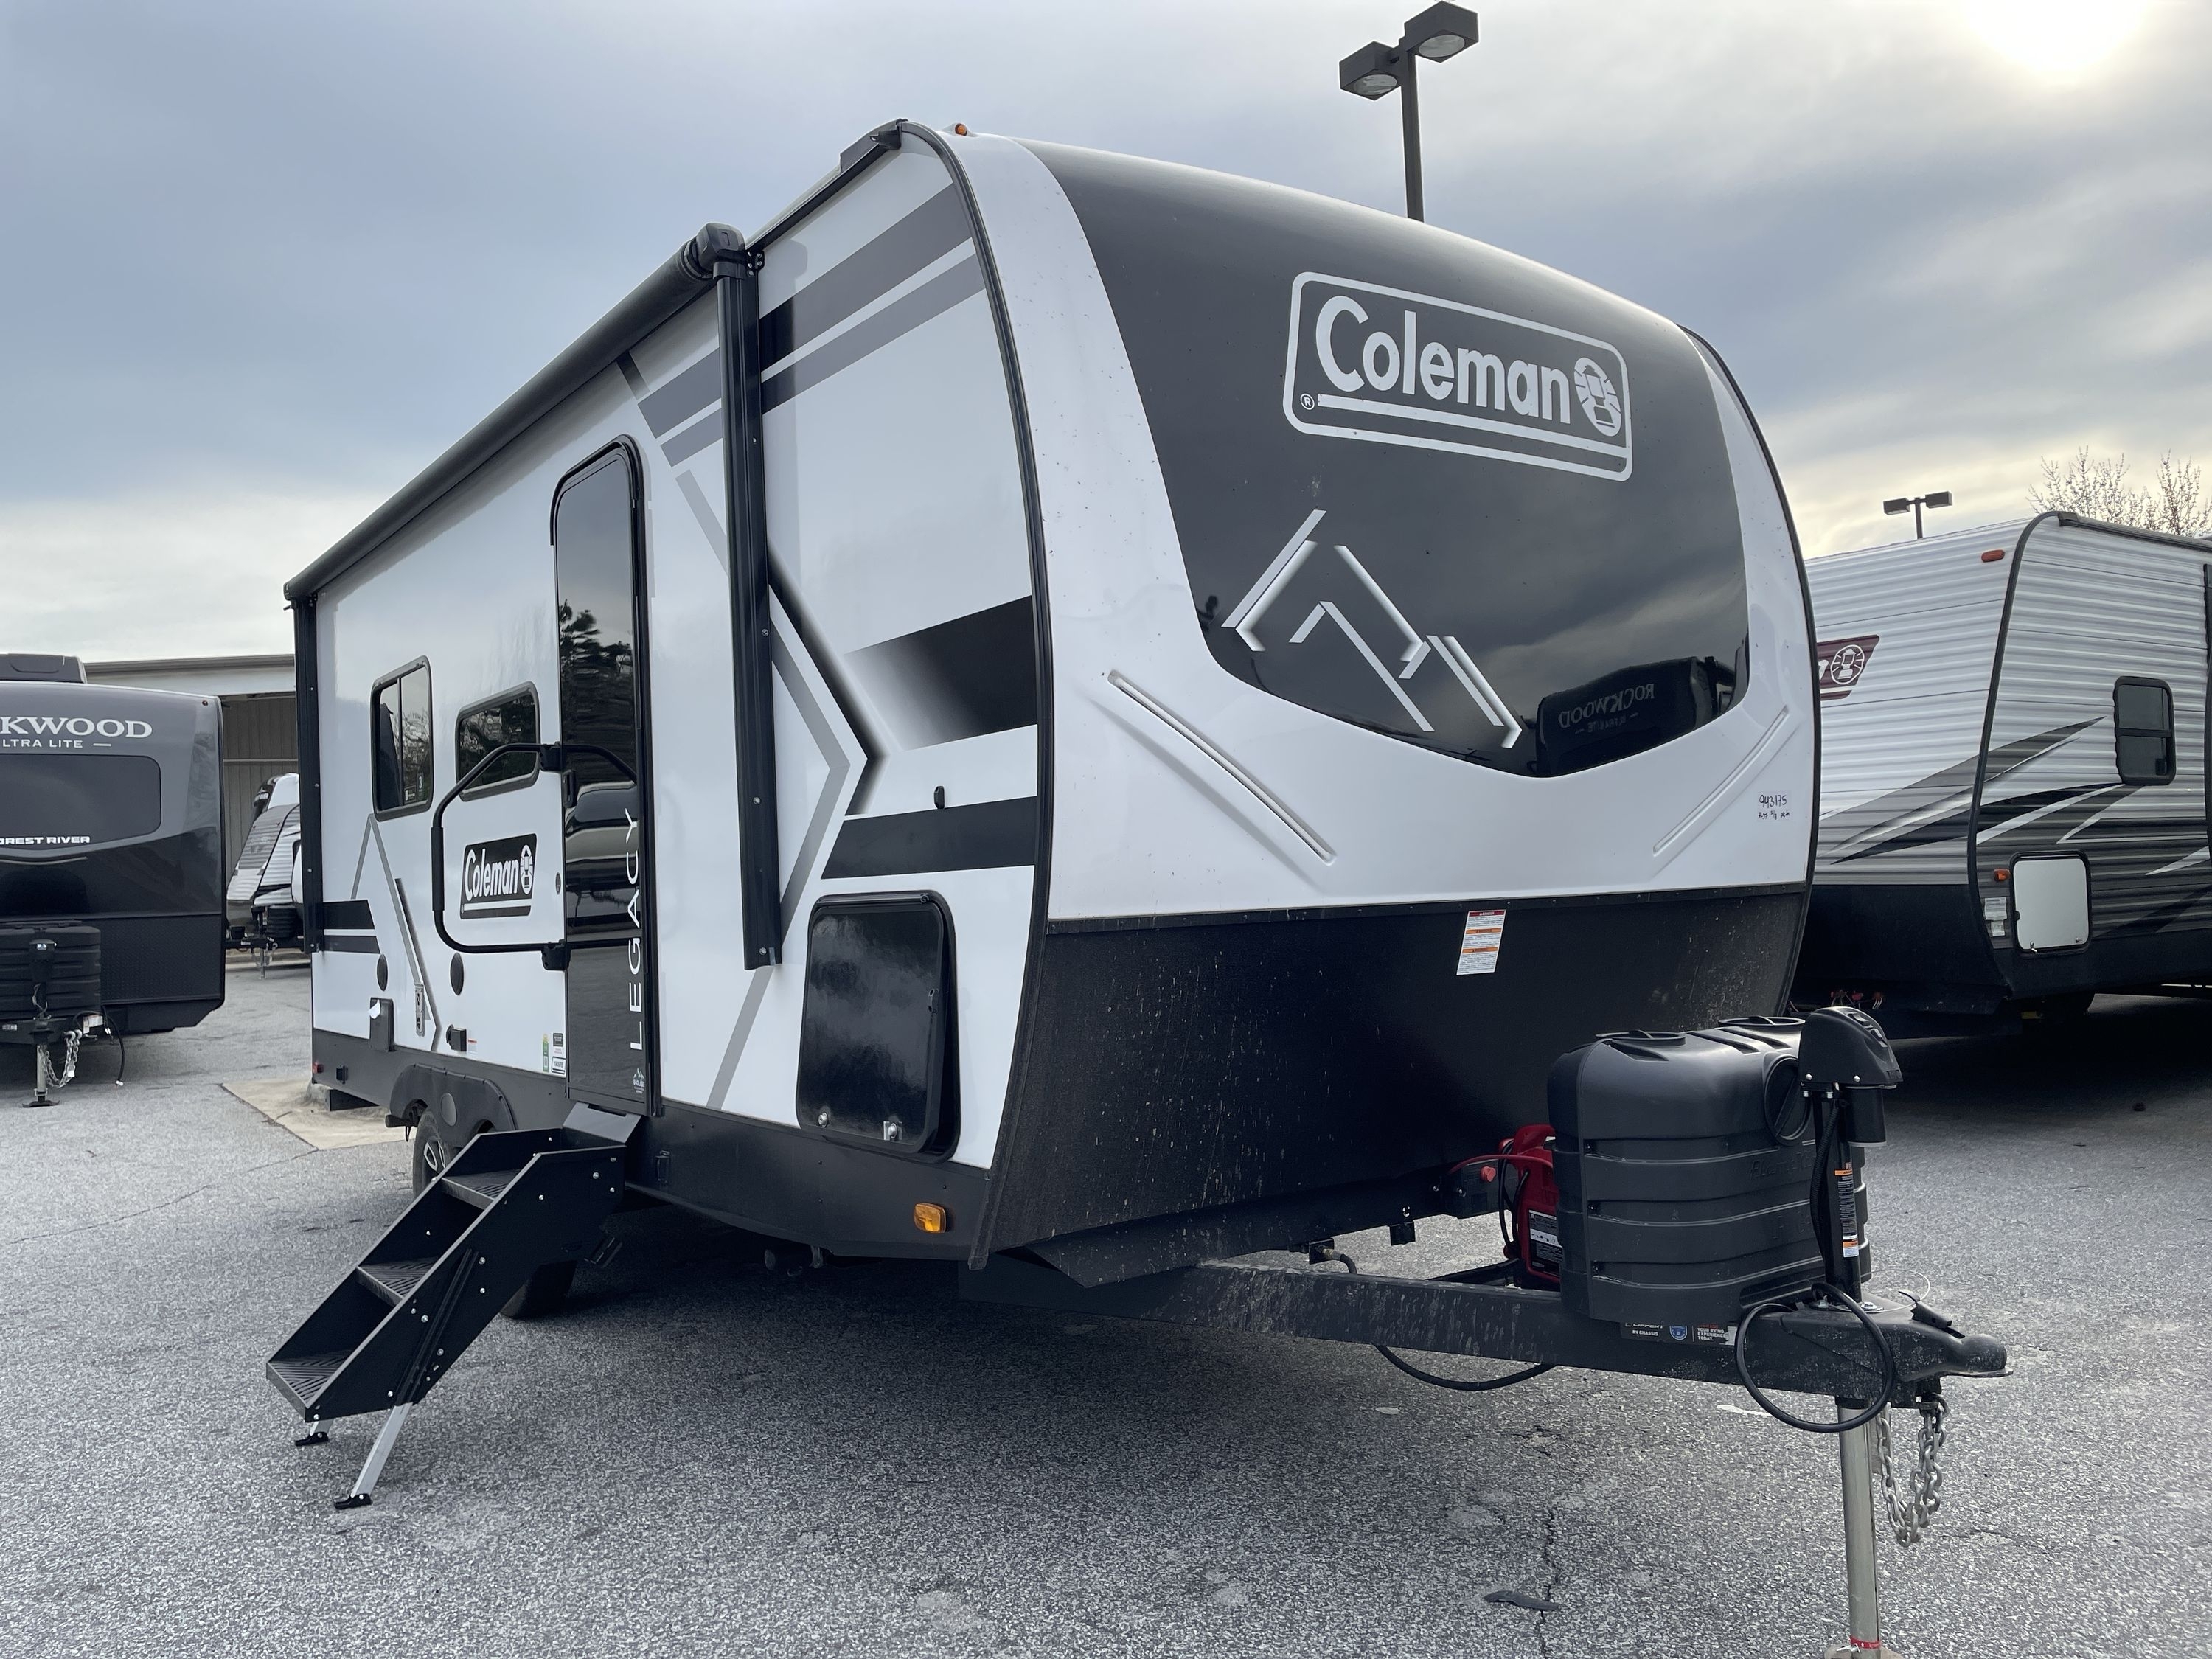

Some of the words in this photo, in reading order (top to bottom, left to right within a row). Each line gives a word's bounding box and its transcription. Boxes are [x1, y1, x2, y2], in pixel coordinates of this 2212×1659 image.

[1316, 296, 1571, 424] Coleman
[49, 740, 83, 748] LITE
[46, 835, 91, 844] RIVER
[465, 848, 519, 901] Coleman
[625, 807, 643, 1051] LEGACY
